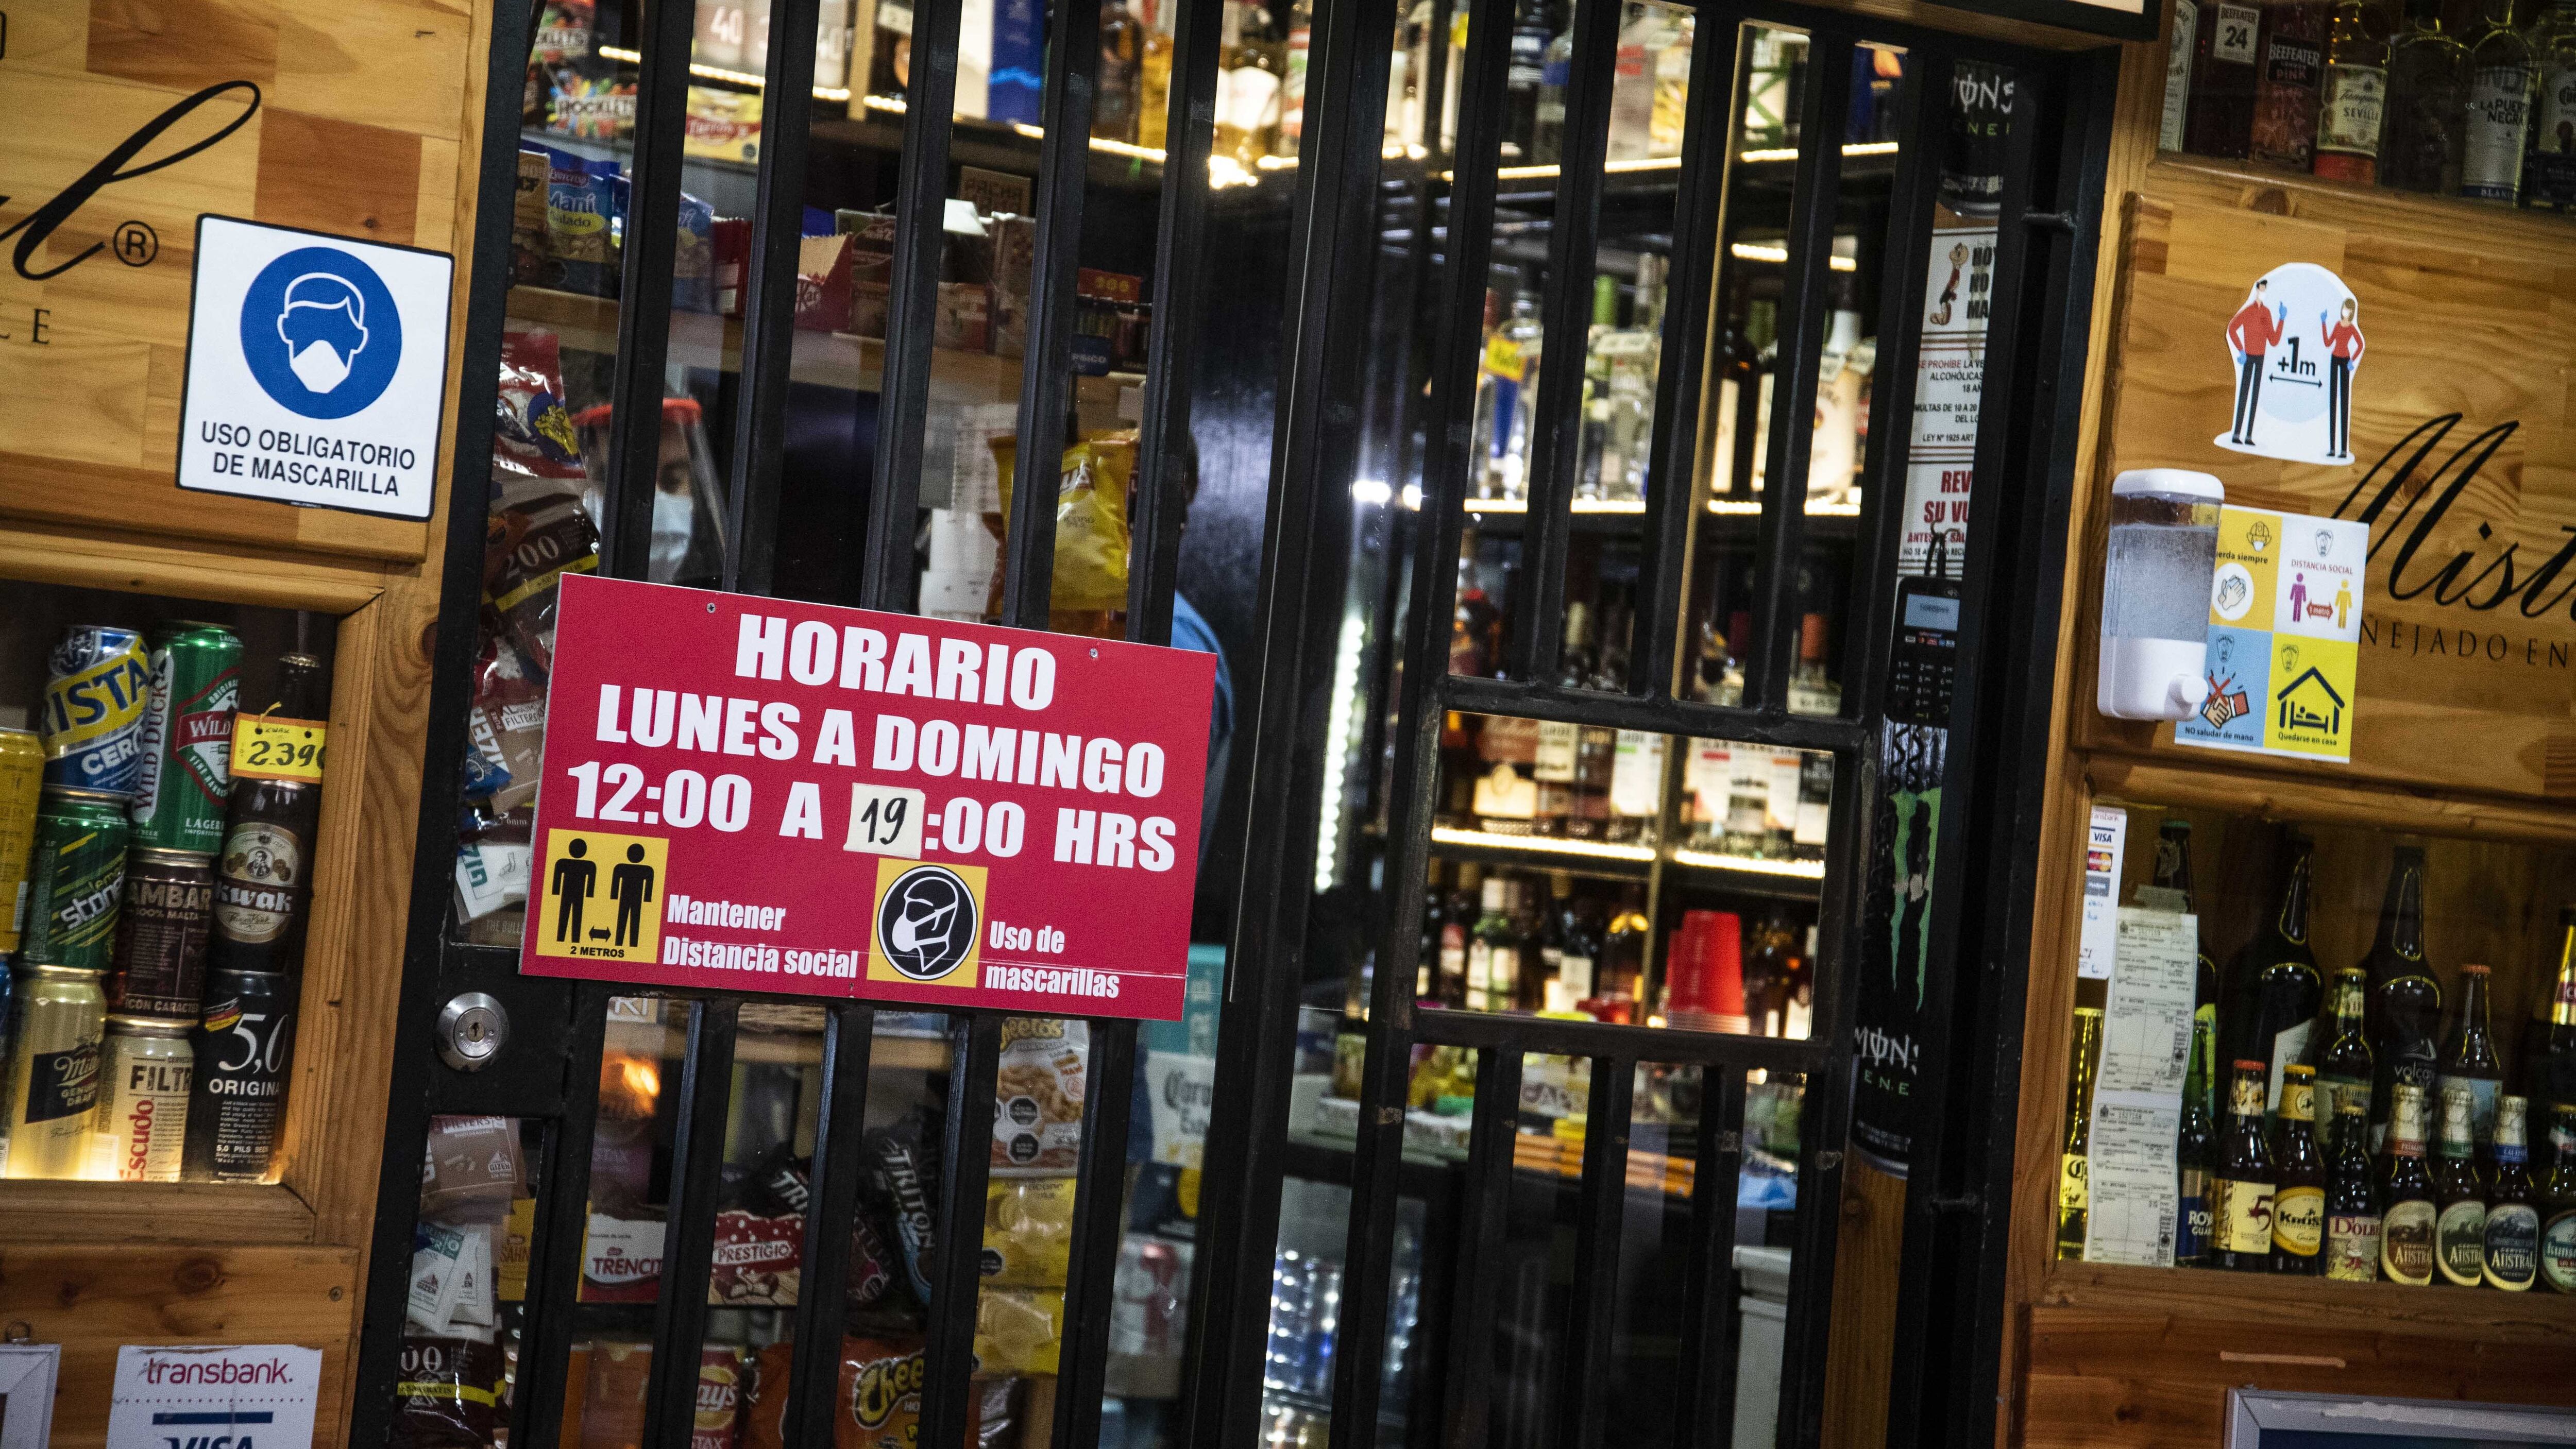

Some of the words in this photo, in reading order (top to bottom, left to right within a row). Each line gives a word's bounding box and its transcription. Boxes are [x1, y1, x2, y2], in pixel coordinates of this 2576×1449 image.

[2224, 26, 2248, 49] 24
[2269, 43, 2320, 67] BEEFEATER
[1963, 359, 1974, 369] LA
[1942, 403, 1952, 412] DE
[1963, 403, 1968, 411] A
[1955, 415, 1967, 423] DEL
[201, 421, 250, 447] USO
[259, 429, 415, 470] OBLIGATORIO
[1922, 434, 1935, 442] LEY
[213, 452, 244, 476] DE
[252, 457, 400, 497] MASCARILLA
[1923, 500, 1945, 523] SU
[2238, 552, 2268, 564] siempre
[2291, 558, 2327, 572] DISTANCIA
[2329, 564, 2353, 575] SOCIAL
[735, 613, 1056, 710] HORARIO
[144, 681, 167, 745] DUCK
[189, 713, 231, 738] WILD
[2185, 726, 2196, 735] NO
[2197, 728, 2222, 739] saludar
[2223, 730, 2232, 740] de
[2233, 734, 2254, 743] mano
[596, 684, 801, 760] LUNES
[812, 708, 856, 767] A
[872, 714, 1165, 798] DOMINGO
[2278, 731, 2311, 744] Quedarse
[2321, 738, 2337, 746] casa
[133, 751, 159, 809] WILD
[567, 761, 752, 832] 12:00
[778, 781, 823, 840] A
[1054, 807, 1176, 872] HRS
[2093, 832, 2112, 843] VISA
[213, 880, 294, 912] kwak
[667, 894, 786, 932] Mantener
[989, 920, 1032, 952] Uso
[1036, 925, 1065, 954] de
[570, 946, 579, 956] 2
[579, 947, 625, 959] METROS
[662, 936, 778, 973] Distancia
[783, 949, 858, 978] social
[984, 964, 1120, 998] mascarillas
[218, 1013, 289, 1073] 5,0
[717, 1241, 792, 1263] PRESTIGIO
